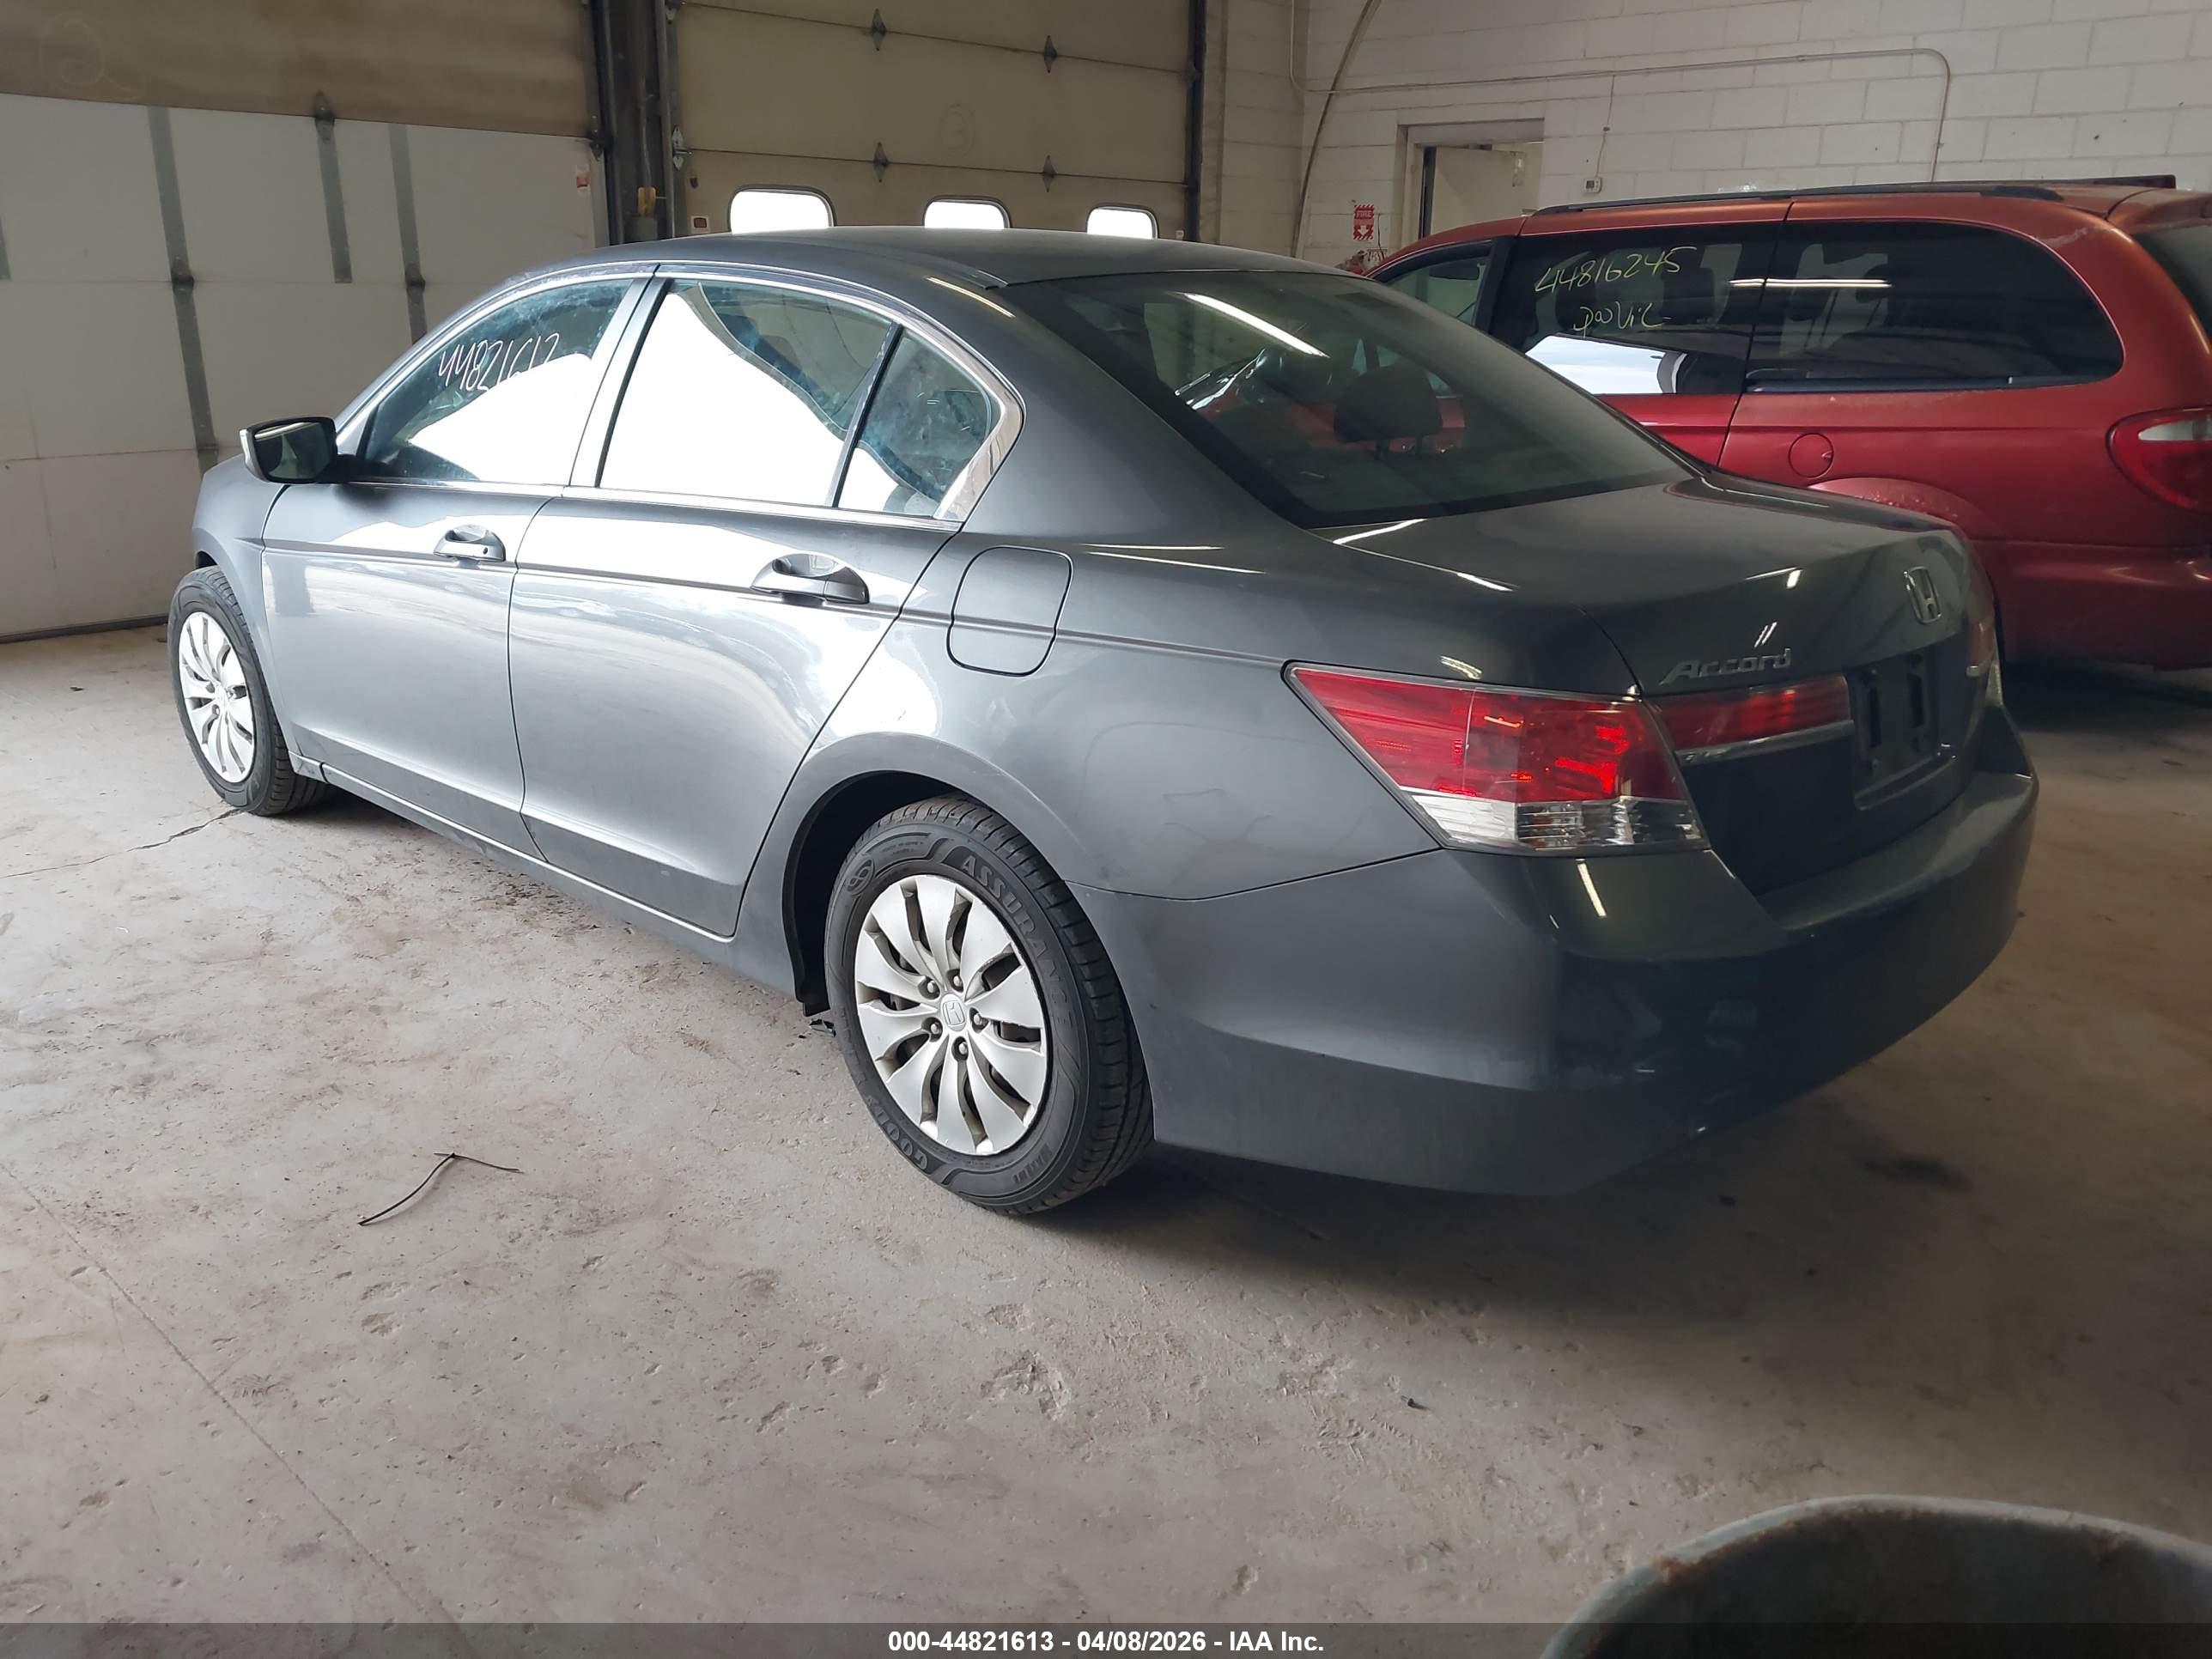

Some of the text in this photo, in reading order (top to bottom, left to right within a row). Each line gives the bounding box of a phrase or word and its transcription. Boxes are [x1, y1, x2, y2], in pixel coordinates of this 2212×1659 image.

[1356, 210, 1372, 218] FIRE
[1534, 246, 1698, 294] 44816245
[1659, 647, 1791, 686] Accord
